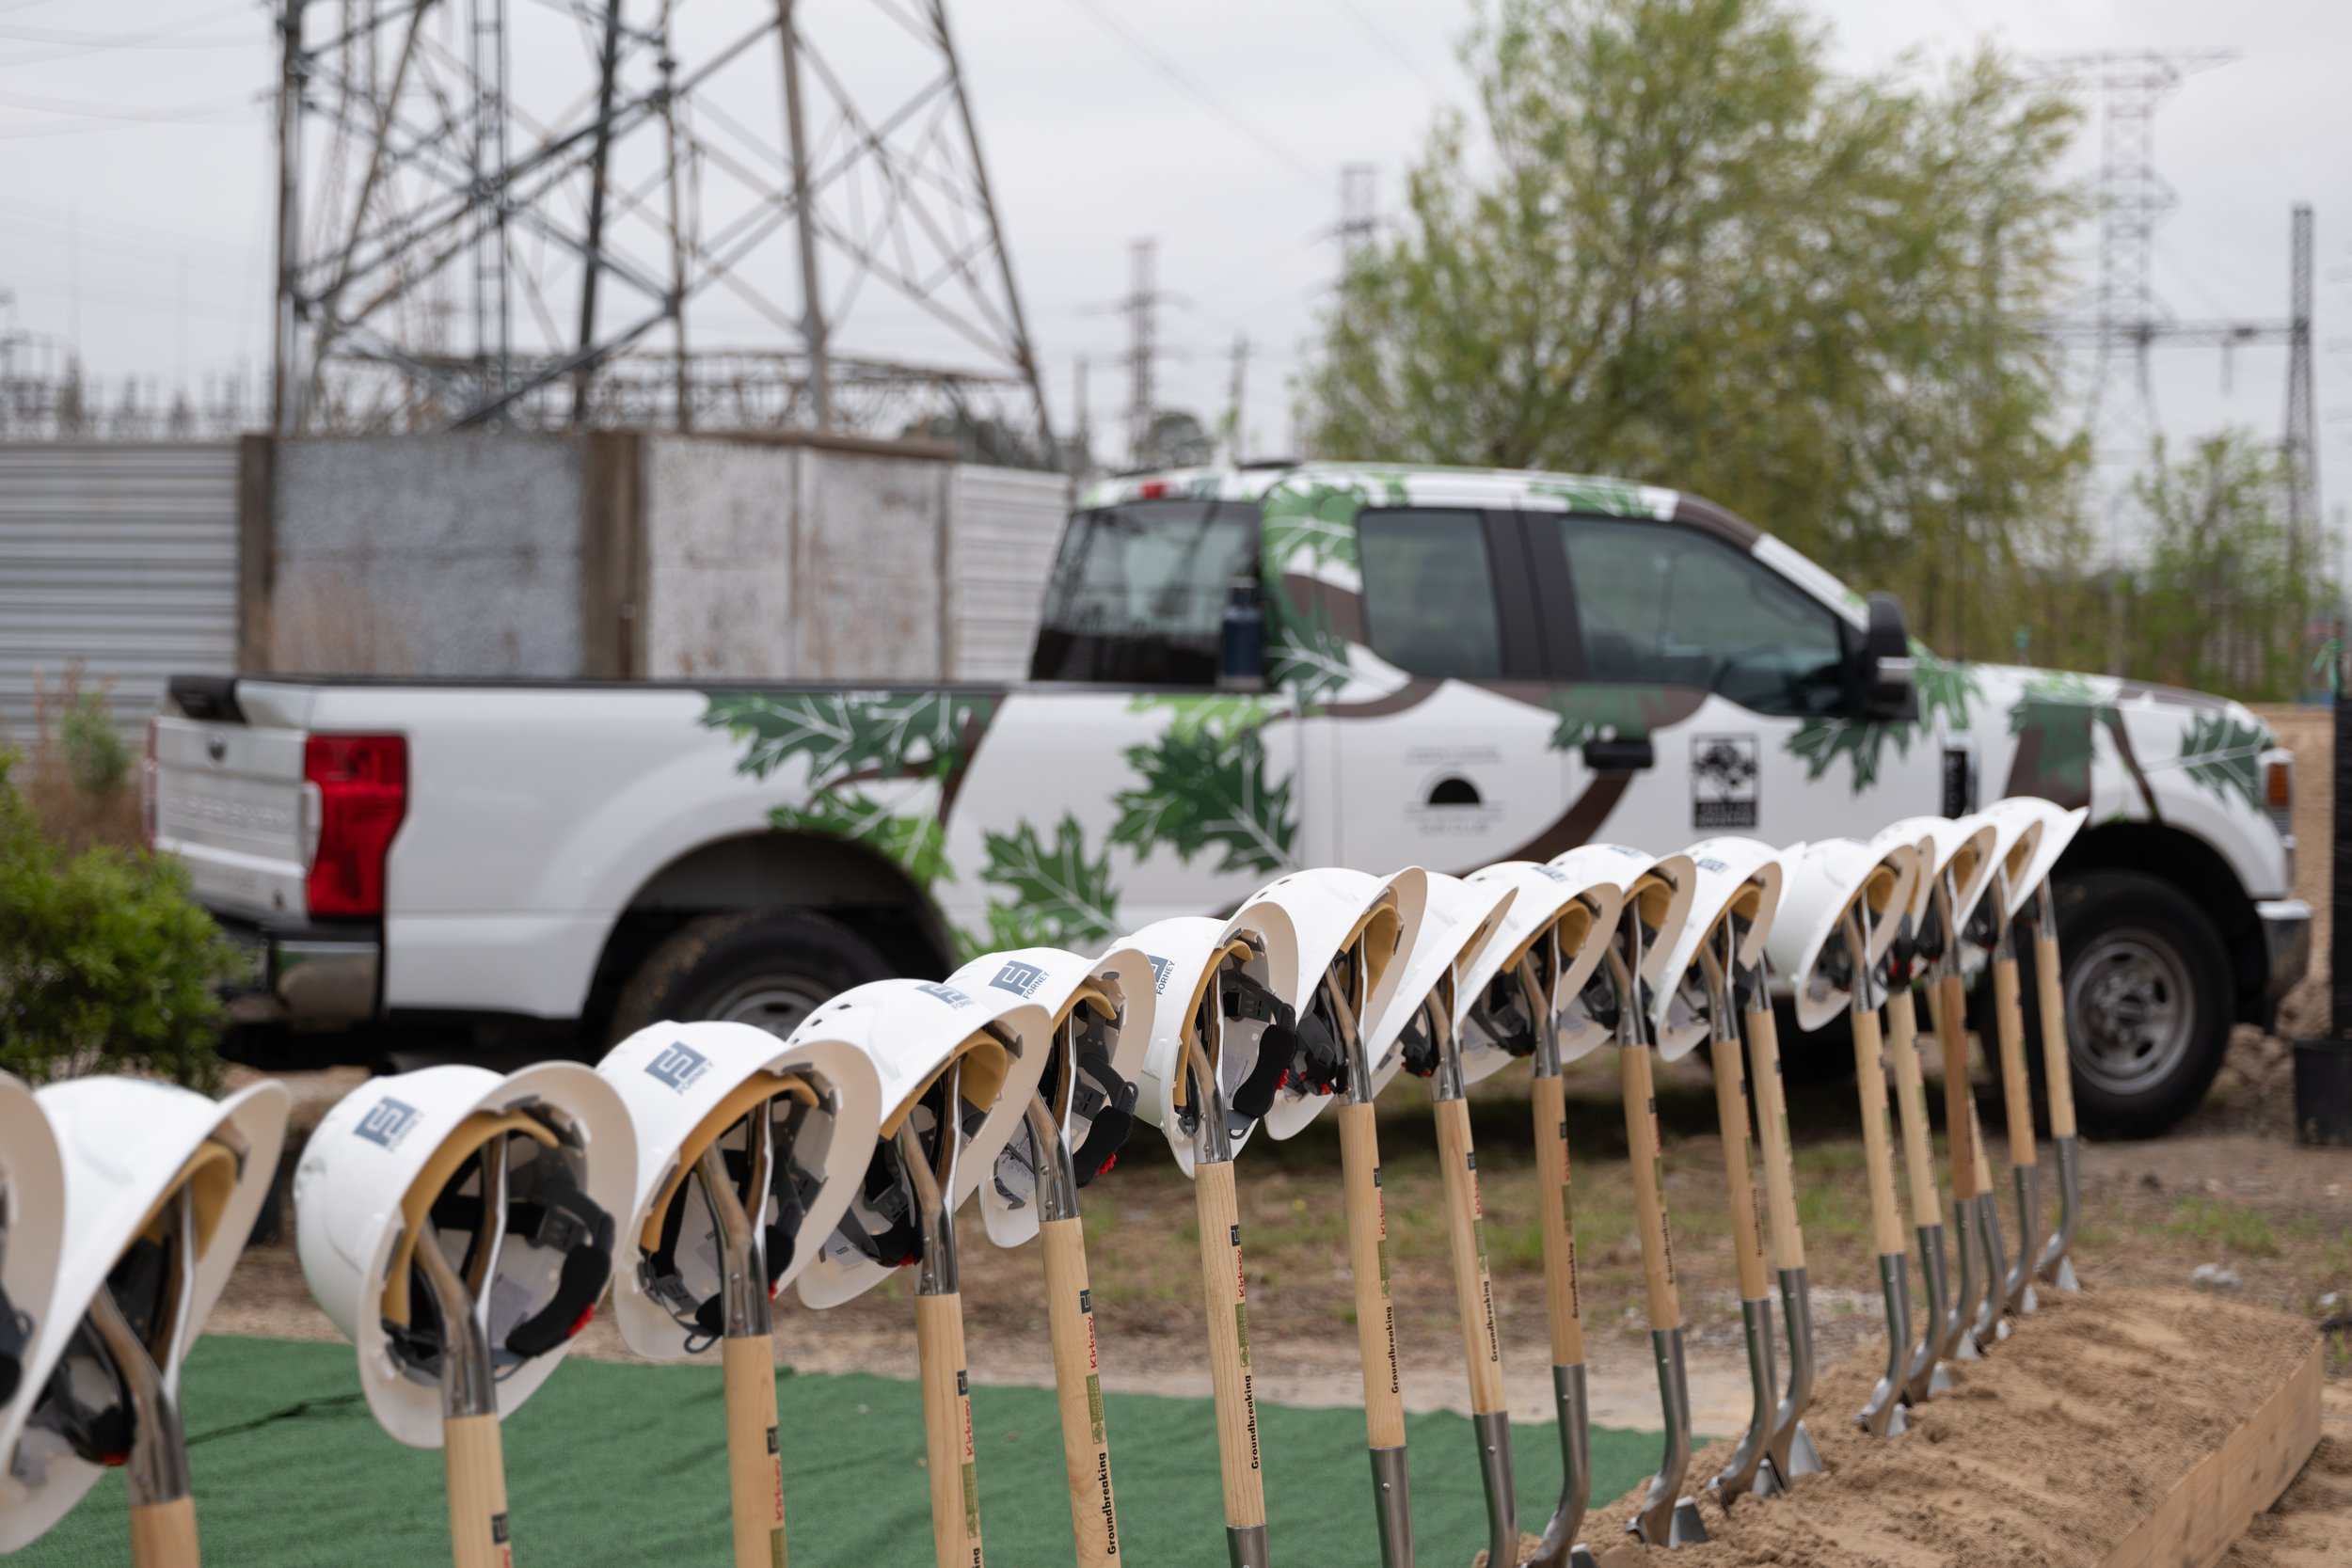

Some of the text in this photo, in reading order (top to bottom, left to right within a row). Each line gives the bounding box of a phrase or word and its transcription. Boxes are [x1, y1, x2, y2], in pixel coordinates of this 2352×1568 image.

[1022, 971, 1050, 1000] FORNEY
[1155, 960, 1175, 995] FORNEY
[1089, 1317, 1098, 1369] Kirksey
[1386, 1307, 1399, 1394] Groundbreaking
[1483, 1281, 1499, 1362] Groundbreaking
[963, 1400, 974, 1456] Kirksey
[1245, 1375, 1259, 1469] Groundbreaking
[1098, 1452, 1116, 1555] Groundbreaking
